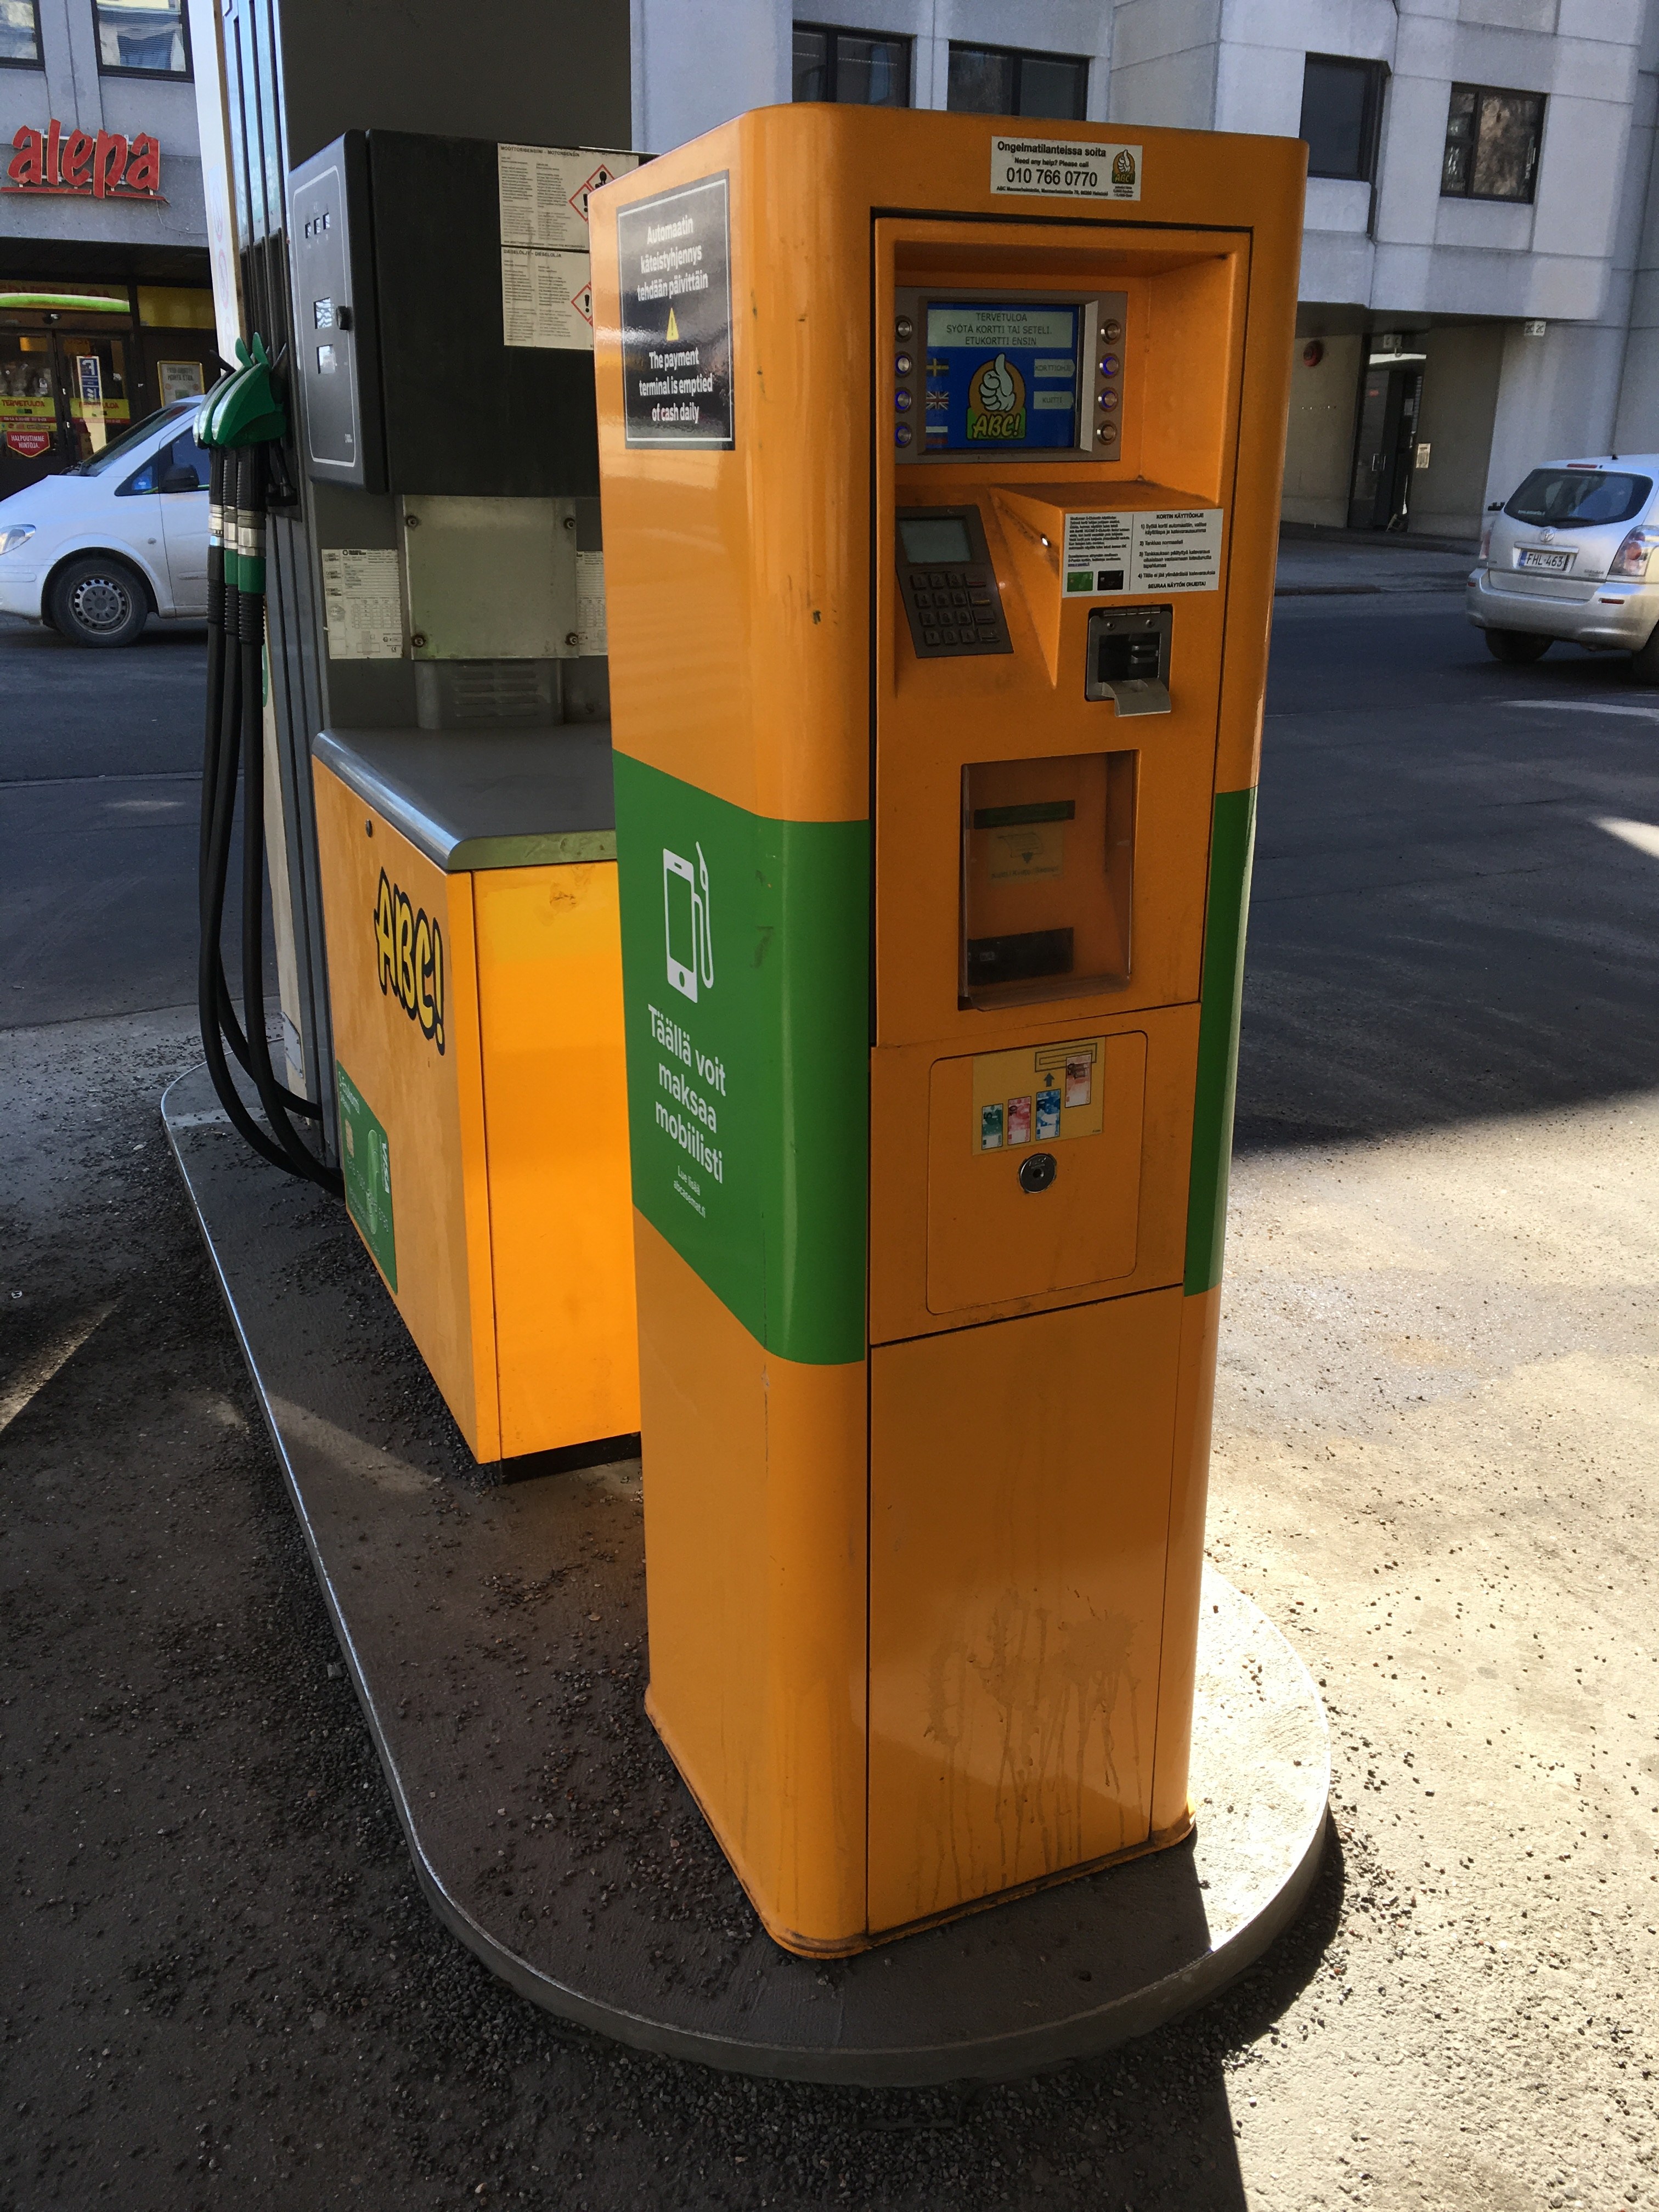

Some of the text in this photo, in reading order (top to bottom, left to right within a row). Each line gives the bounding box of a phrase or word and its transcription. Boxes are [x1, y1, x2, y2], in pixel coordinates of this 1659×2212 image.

[7, 118, 160, 199] alepa
[997, 140, 1107, 157] Ongelmatilanteissa soita
[1007, 167, 1097, 187] 010 766 0770
[647, 215, 693, 245] Automaatin
[641, 245, 702, 274] käteistyhjennys
[637, 269, 708, 301] tehdään päivittäin
[975, 312, 1028, 321] TERVETULOA
[965, 336, 1036, 346] ETUKORTTI ENSIN
[976, 325, 1005, 334] KORTTI
[1008, 325, 1020, 334] TAI
[1023, 326, 1052, 335] SETELI.
[648, 347, 699, 371] The payment
[639, 373, 713, 397] terminal is emptied
[652, 402, 699, 424] of cash daily
[972, 413, 1022, 439] ABC!
[1526, 553, 1564, 567] FHL-463
[374, 866, 445, 1056] ABC!
[648, 1003, 726, 1096] Täällä voit
[659, 1062, 716, 1133] maksaa
[656, 1101, 723, 1184] mobiilisti
[678, 1165, 701, 1196] Lue lisää
